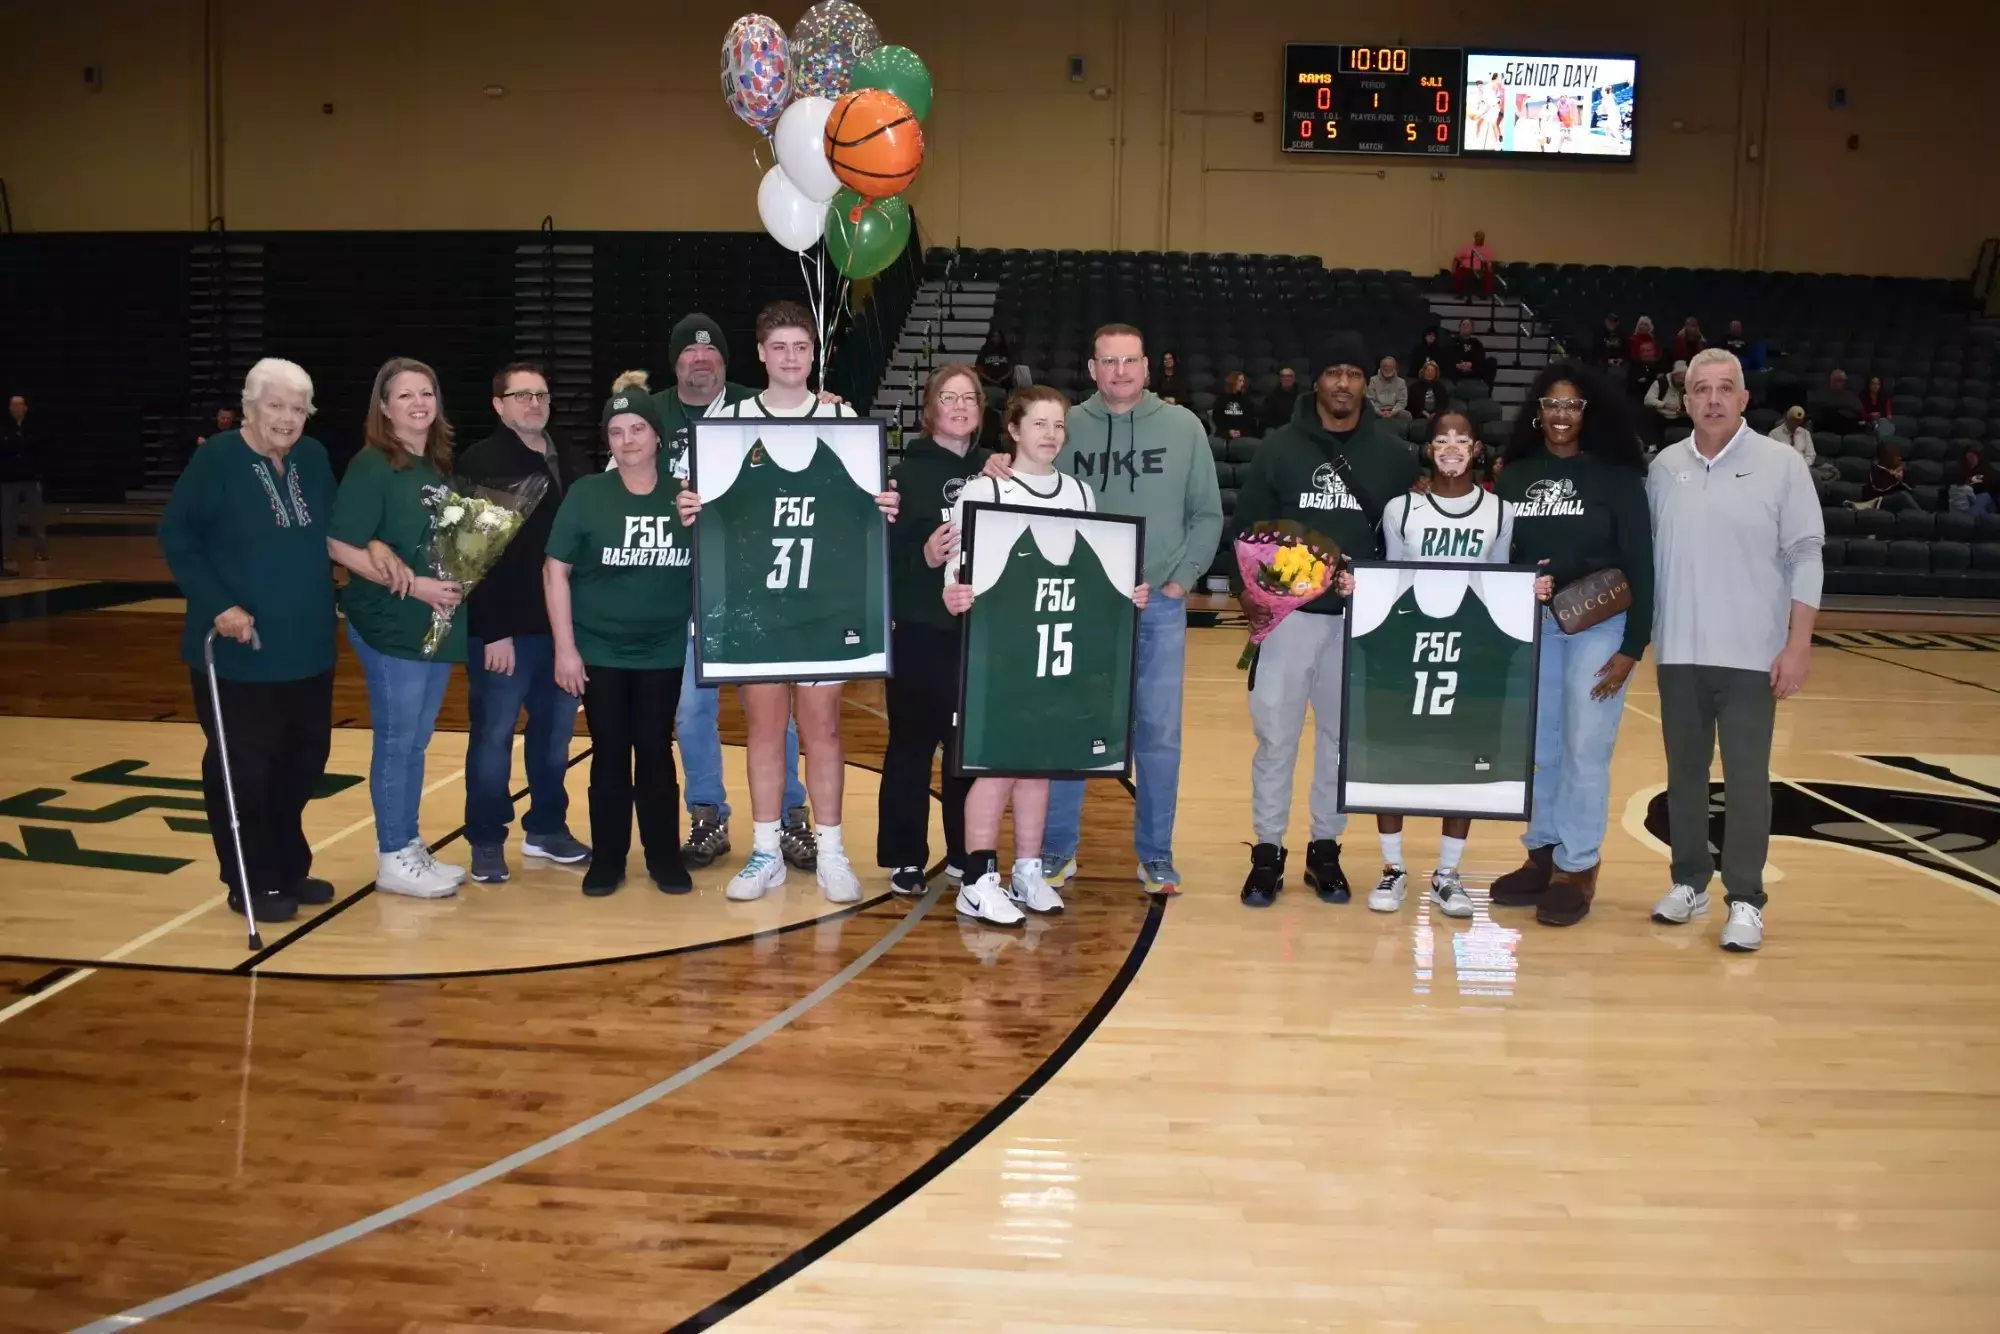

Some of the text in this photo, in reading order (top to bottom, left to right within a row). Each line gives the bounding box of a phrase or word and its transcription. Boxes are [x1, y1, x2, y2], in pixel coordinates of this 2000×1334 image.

[1351, 48, 1406, 71] 10:00
[1298, 73, 1332, 84] RAMS
[1420, 76, 1443, 87] SJLI
[1504, 62, 1598, 89] SENIOR DAY!
[1317, 87, 1331, 110] 0
[1373, 92, 1379, 108] 1
[1436, 91, 1449, 113] 0
[1292, 111, 1315, 120] FOULS
[1428, 115, 1452, 123] FOULS
[1301, 120, 1312, 138] 0
[1326, 121, 1337, 138] 5
[1406, 123, 1417, 141] 5
[1437, 123, 1448, 142] 0
[1292, 141, 1314, 149] SCORE
[1428, 145, 1450, 153] SCORE
[1074, 447, 1167, 478] NIKE
[773, 497, 815, 527] FSC
[623, 516, 673, 548] FSC
[1421, 527, 1484, 557] RAMS
[602, 547, 691, 566] BASKETBALL
[766, 538, 813, 589] 31
[1034, 578, 1075, 612] FSC
[1559, 588, 1616, 621] GUCCI
[1036, 622, 1073, 677] 15
[1412, 632, 1462, 662] FSC
[1412, 671, 1458, 715] 12
